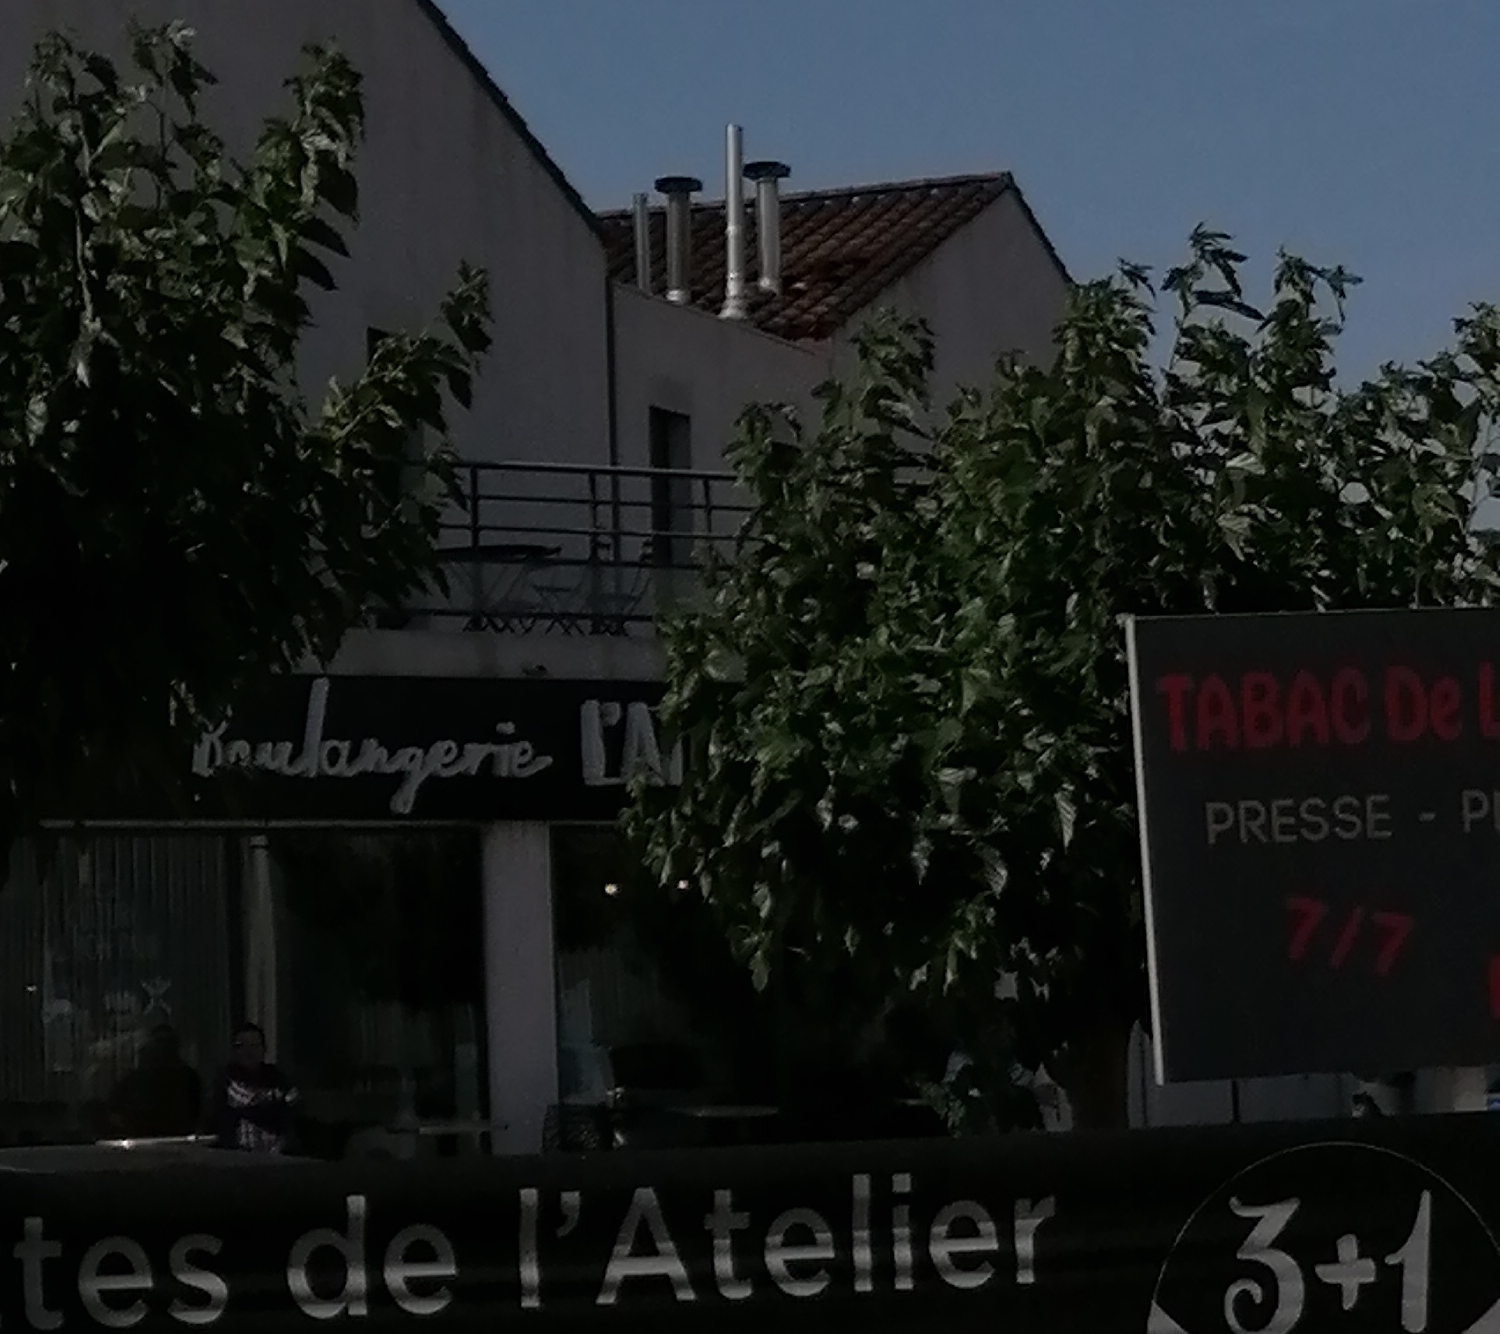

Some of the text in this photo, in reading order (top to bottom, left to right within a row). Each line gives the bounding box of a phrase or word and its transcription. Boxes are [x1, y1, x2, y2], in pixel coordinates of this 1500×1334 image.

[1156, 666, 1371, 753] TABAC
[1384, 664, 1463, 746] De
[1205, 793, 1394, 846] PRESSE
[1286, 897, 1414, 979] 7/7
[285, 1193, 460, 1320] de
[519, 1171, 1059, 1310] l'Atelier
